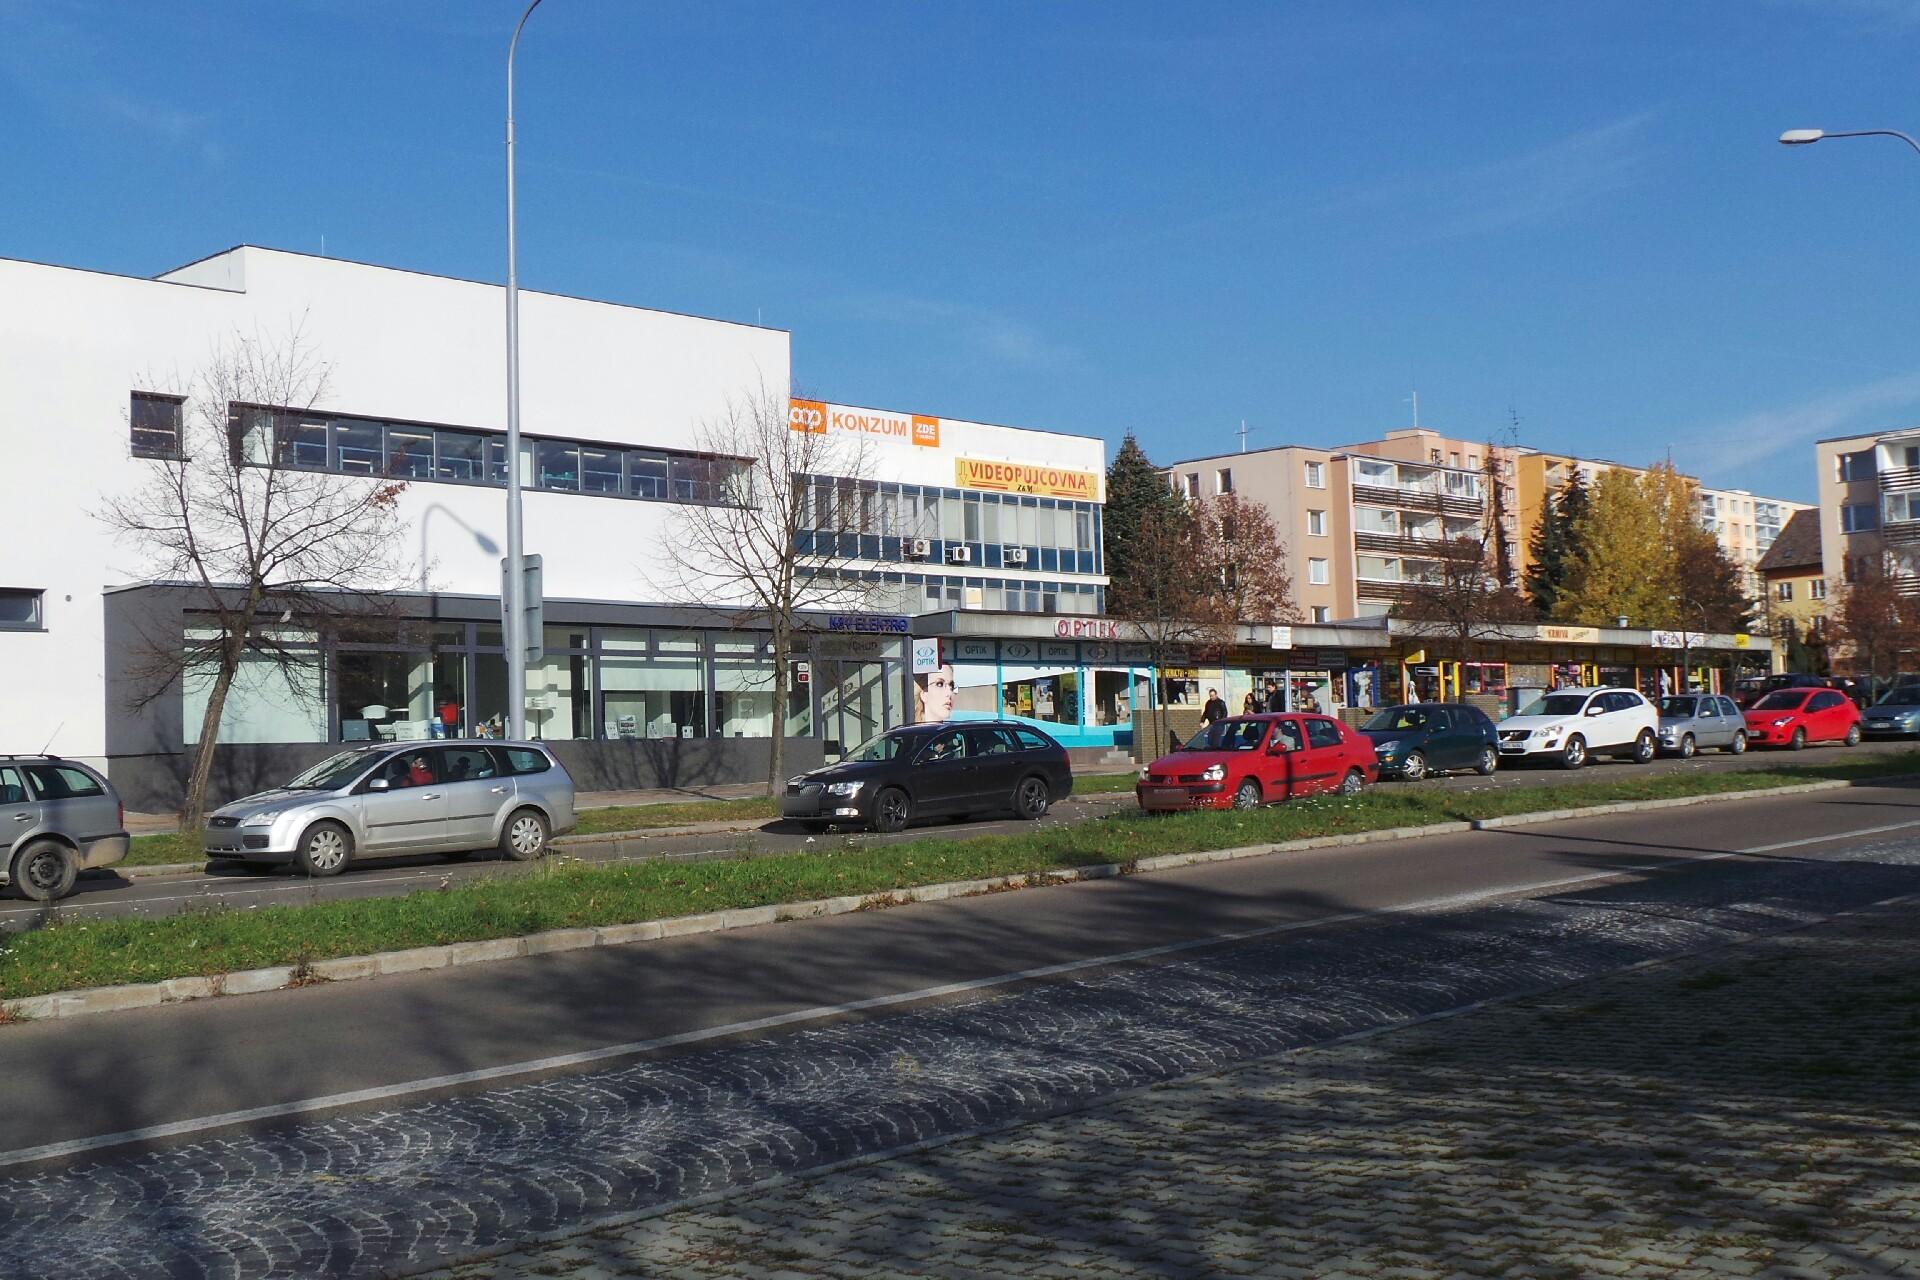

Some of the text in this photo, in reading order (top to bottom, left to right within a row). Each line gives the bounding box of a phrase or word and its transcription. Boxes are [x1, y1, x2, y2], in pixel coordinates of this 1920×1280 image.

[832, 411, 908, 437] KONZUM
[915, 422, 937, 435] ZDE
[1056, 619, 1119, 639] OPTIK
[964, 645, 988, 655] OPTIK
[1048, 647, 1069, 656] OPTIK
[916, 657, 936, 666] OPTIK
